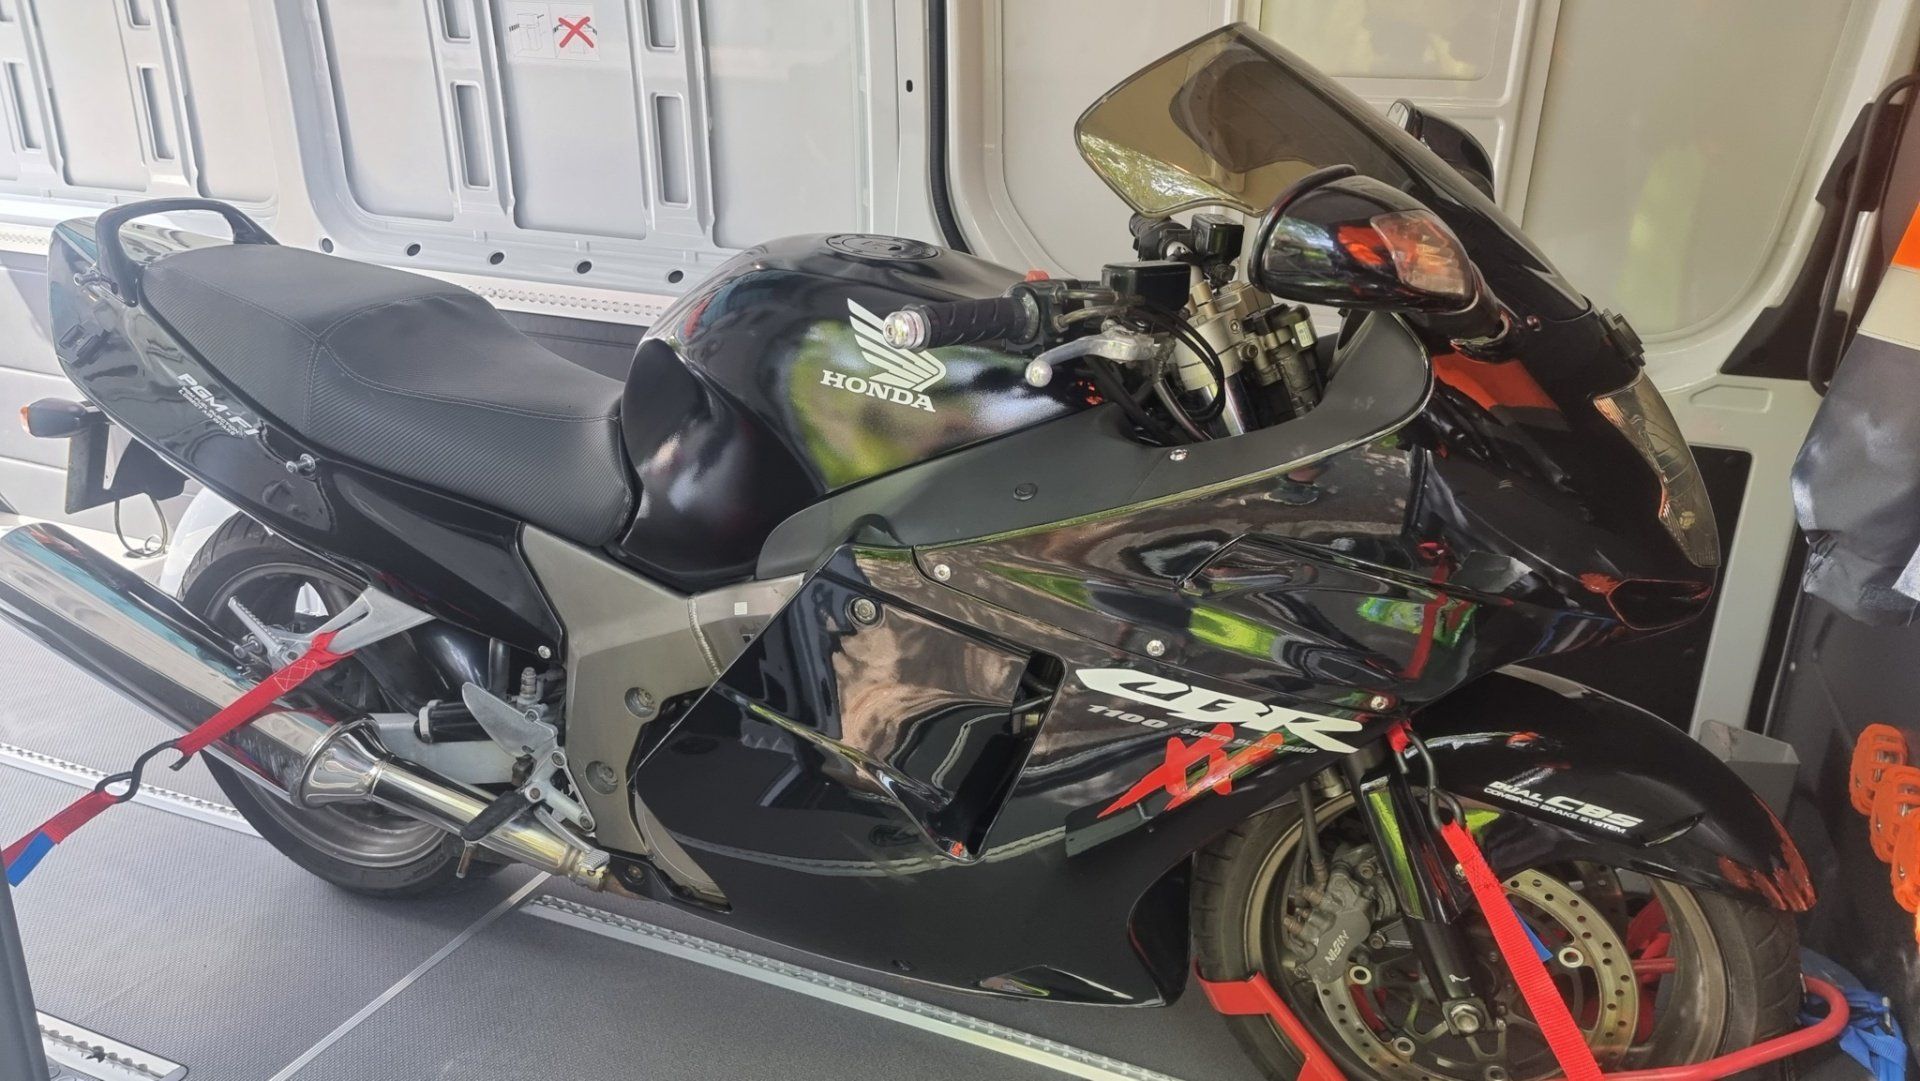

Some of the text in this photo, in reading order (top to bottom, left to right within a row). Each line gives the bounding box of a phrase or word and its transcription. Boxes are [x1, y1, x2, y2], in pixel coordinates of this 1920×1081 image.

[177, 373, 259, 435] PGM-FI
[183, 393, 203, 409] DIRECT
[212, 417, 236, 436] INTAKE
[820, 369, 937, 413] HONDA
[209, 409, 240, 434] INJECTION
[1075, 668, 1363, 754] CBR
[1087, 704, 1318, 754] 1100 SUPER BLACKBIRD
[1096, 722, 1285, 819] XX
[1483, 787, 1627, 834] COMBINED BRAKE SYSTEM
[1488, 780, 1644, 828] DUAL CBS
